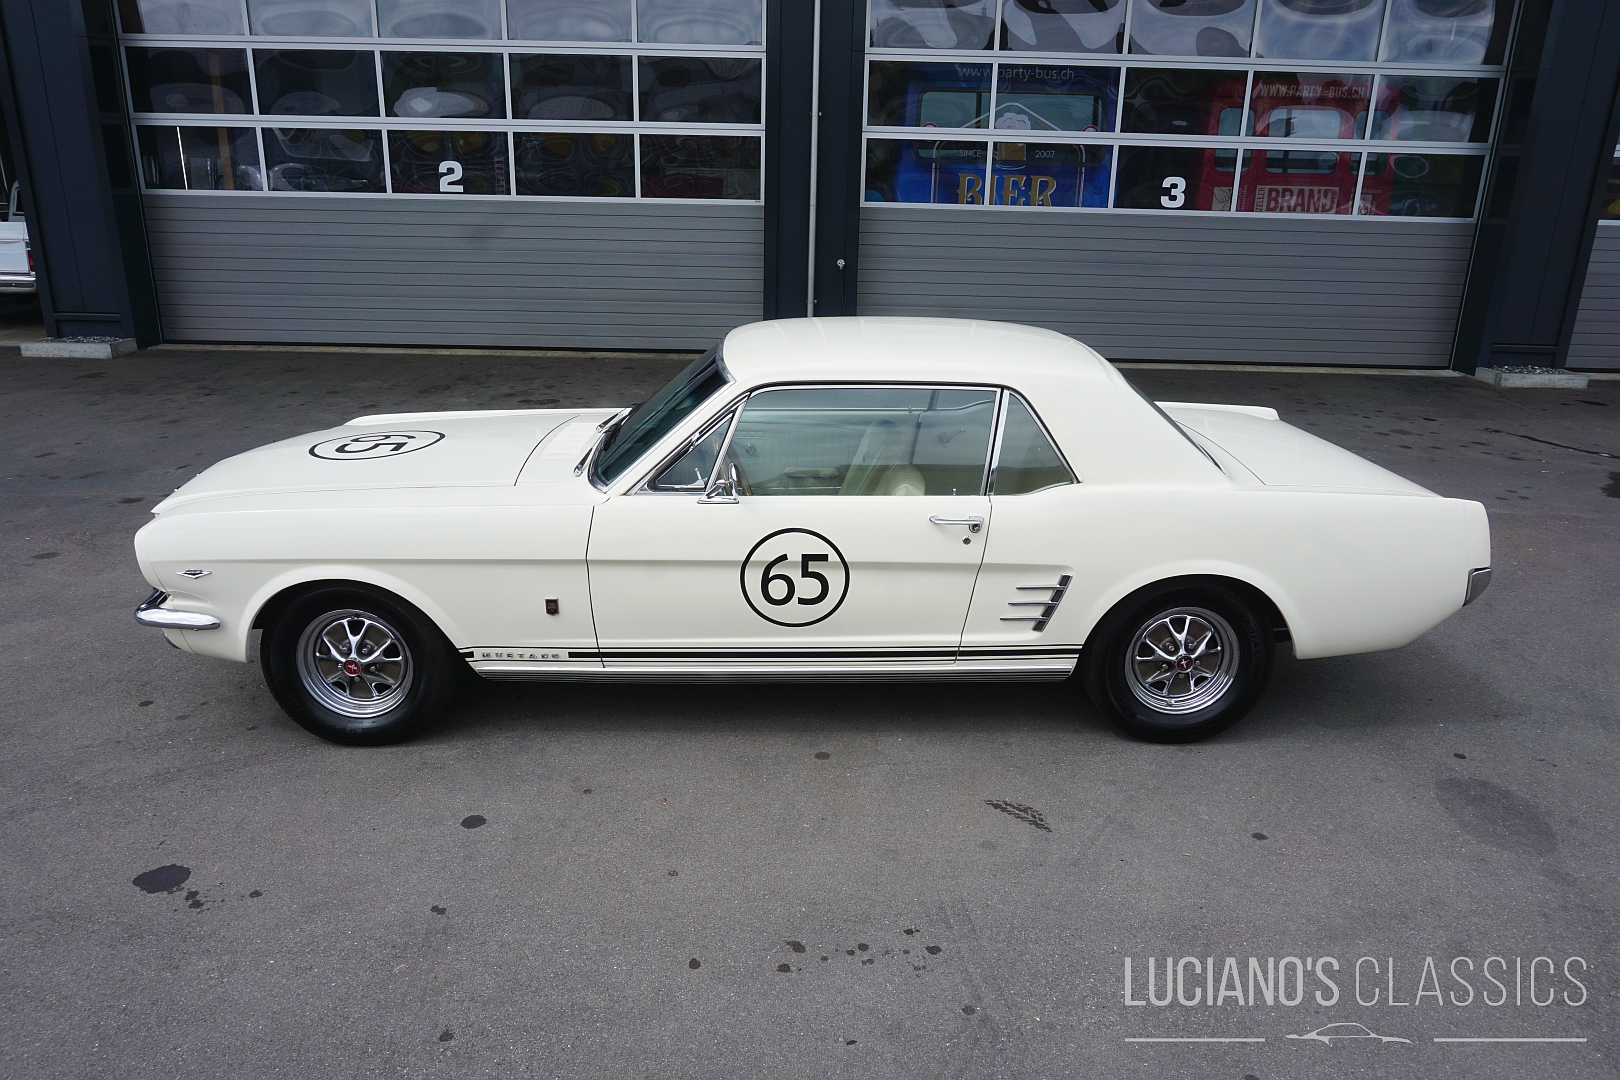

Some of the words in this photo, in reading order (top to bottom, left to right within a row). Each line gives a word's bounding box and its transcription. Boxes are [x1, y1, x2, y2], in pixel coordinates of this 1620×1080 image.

[959, 67, 1075, 81] wwwparty-bus.ch
[1260, 84, 1365, 99] WWW.PARTY-BUS.CH
[959, 149, 982, 158] SINCE
[1035, 150, 1055, 159] 2007
[438, 160, 464, 192] 2
[956, 173, 1057, 206] BIER
[1160, 176, 1187, 208] 3
[1266, 187, 1338, 213] BRAND
[335, 434, 417, 454] 65
[760, 553, 830, 607] 65
[481, 651, 560, 660] MUSTANG
